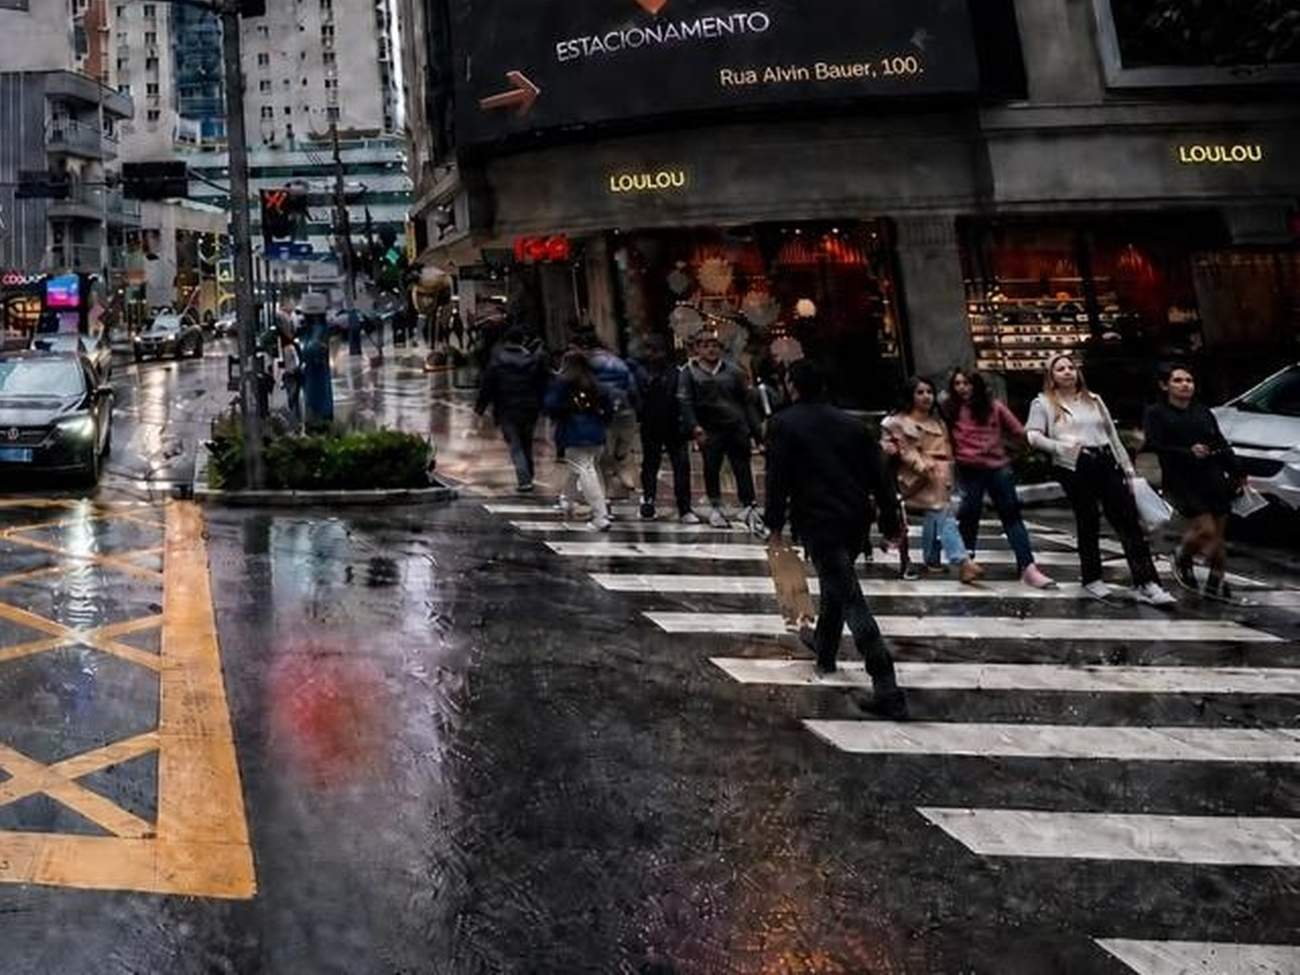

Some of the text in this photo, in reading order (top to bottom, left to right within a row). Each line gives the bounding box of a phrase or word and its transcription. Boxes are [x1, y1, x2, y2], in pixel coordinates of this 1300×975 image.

[556, 11, 770, 62] ESTACIONAMENTO
[720, 56, 925, 86] Rua Alvin Bauer, 100.
[1179, 145, 1263, 163] LOULOU
[610, 171, 684, 192] LOULOU
